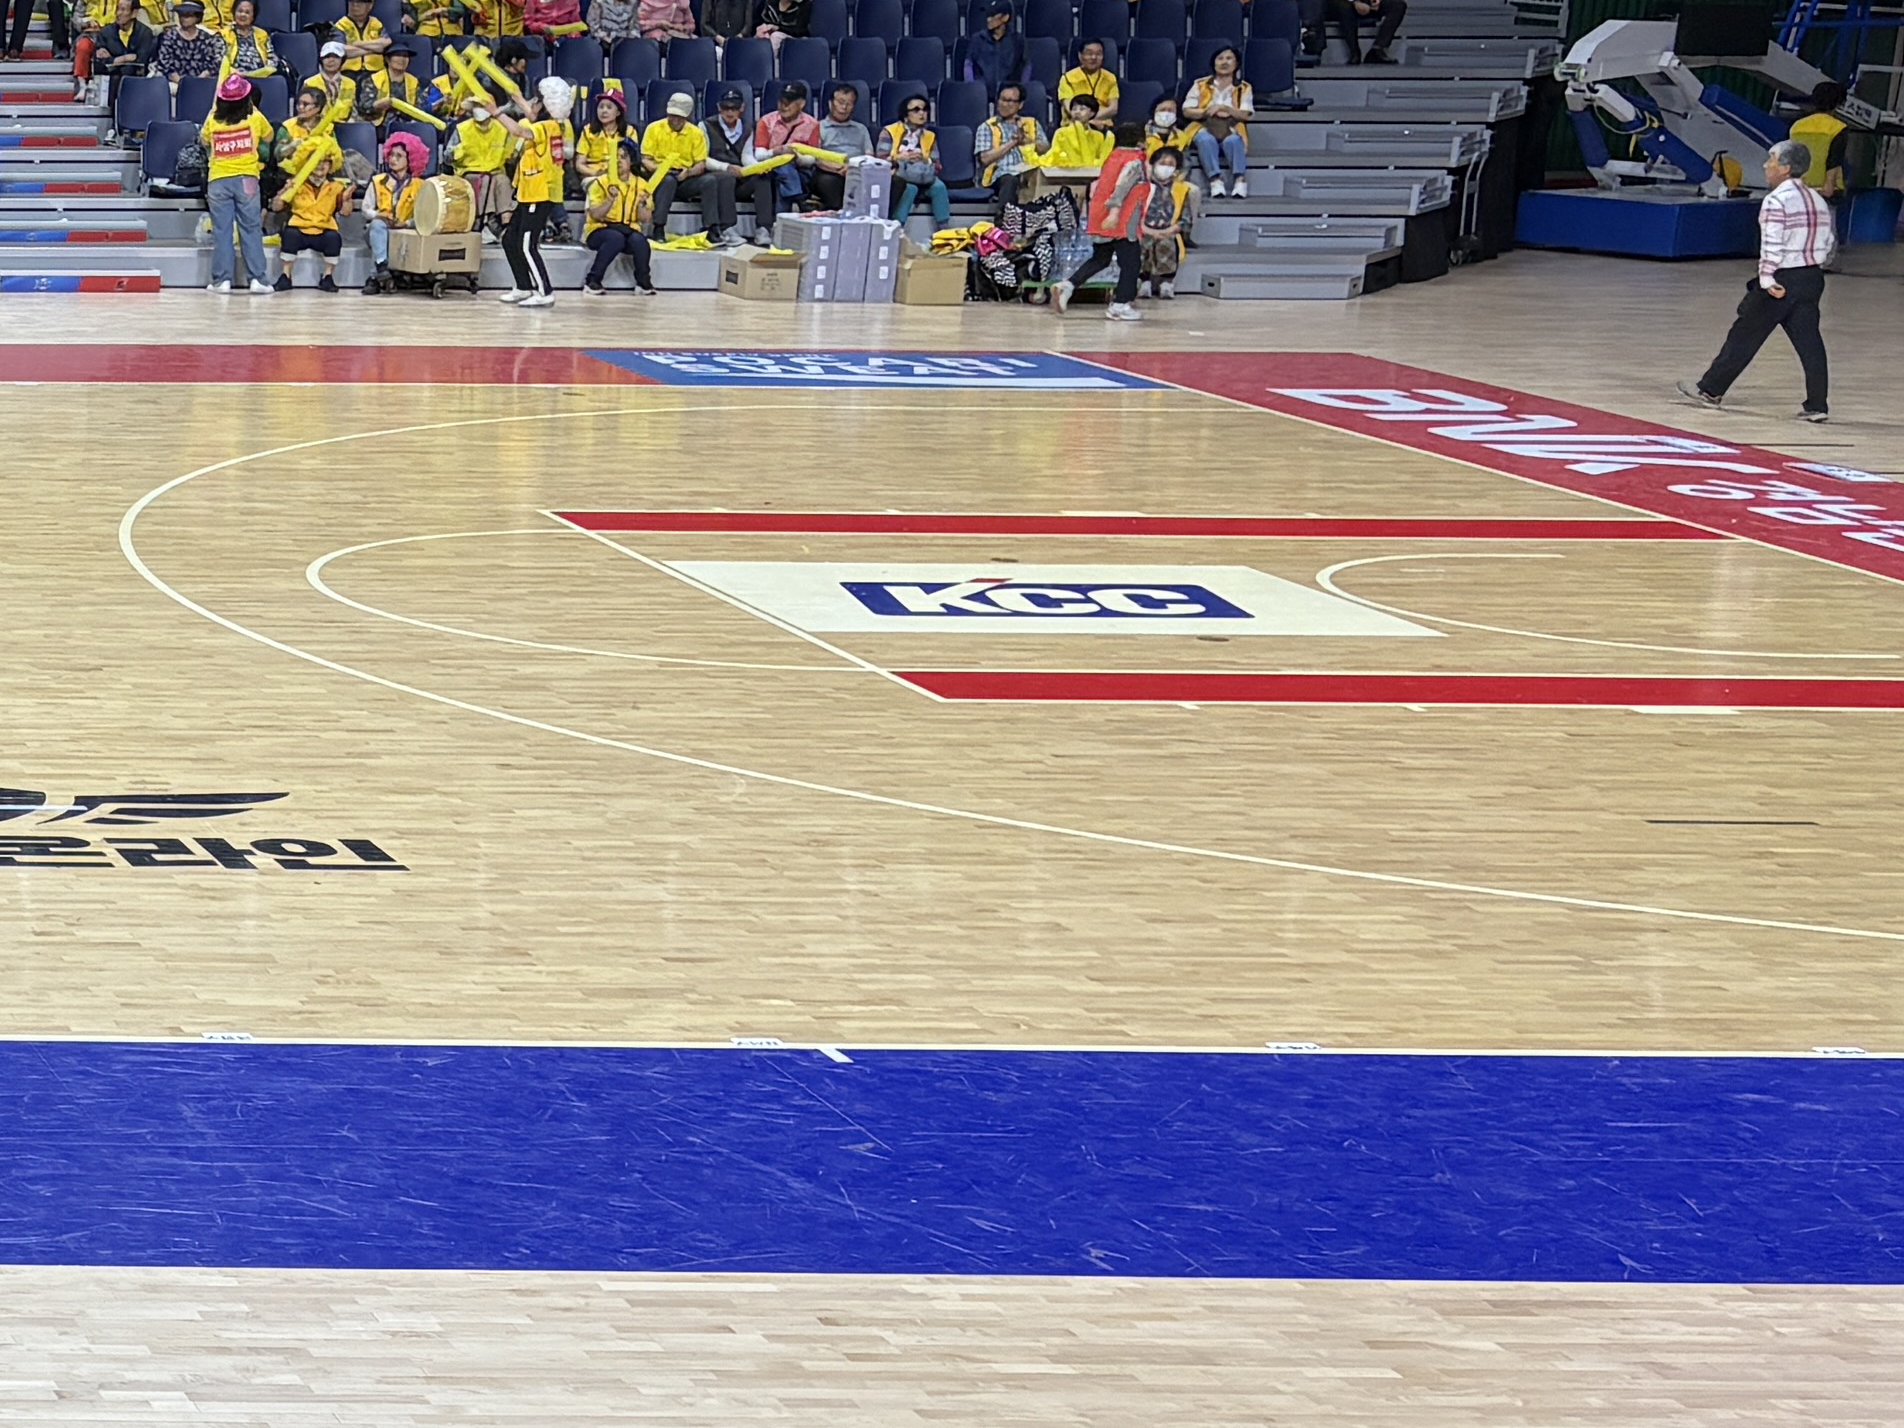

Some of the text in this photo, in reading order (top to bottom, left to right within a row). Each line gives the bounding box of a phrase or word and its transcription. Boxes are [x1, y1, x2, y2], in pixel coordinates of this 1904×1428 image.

[643, 354, 1038, 368] POCARI
[670, 363, 1017, 376] SWEAT
[1266, 387, 1781, 476] BNK
[882, 577, 1208, 615] KCC
